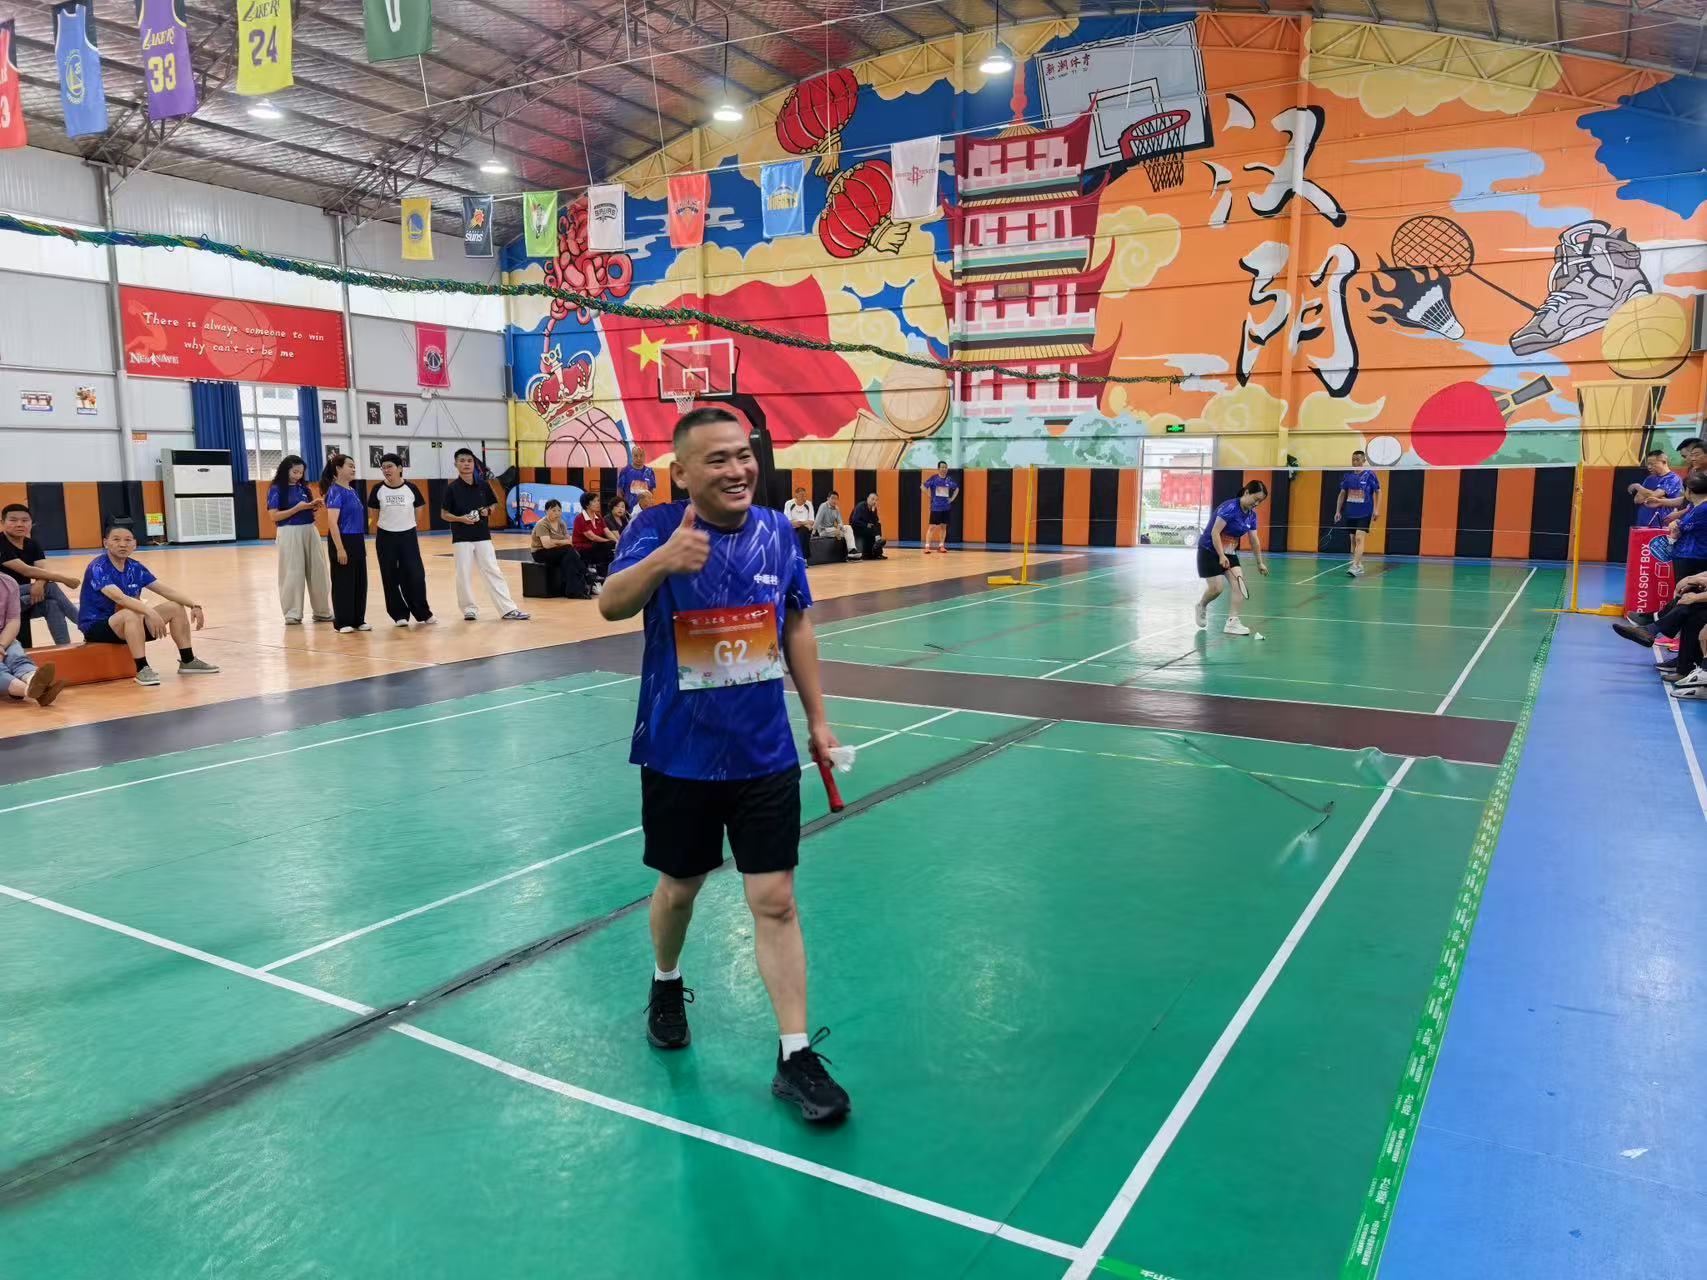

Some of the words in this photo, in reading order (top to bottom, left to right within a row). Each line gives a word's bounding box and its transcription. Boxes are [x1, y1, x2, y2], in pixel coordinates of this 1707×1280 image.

[143, 26, 175, 49] LAKER
[249, 26, 278, 66] 24
[148, 53, 176, 93] 33
[0, 95, 10, 128] 3
[143, 312, 179, 326] There
[187, 319, 197, 328] is
[204, 319, 238, 338] always
[245, 327, 286, 338] someone
[293, 331, 302, 339] to
[309, 332, 324, 341] win
[184, 337, 205, 355] why
[213, 340, 238, 352] can't
[246, 344, 255, 354] it
[262, 344, 273, 355] be
[280, 350, 294, 358] me
[1640, 543, 1651, 563] BOX
[1639, 565, 1650, 589] SOFT
[1636, 590, 1648, 613] PLYO
[714, 640, 750, 666] G2
